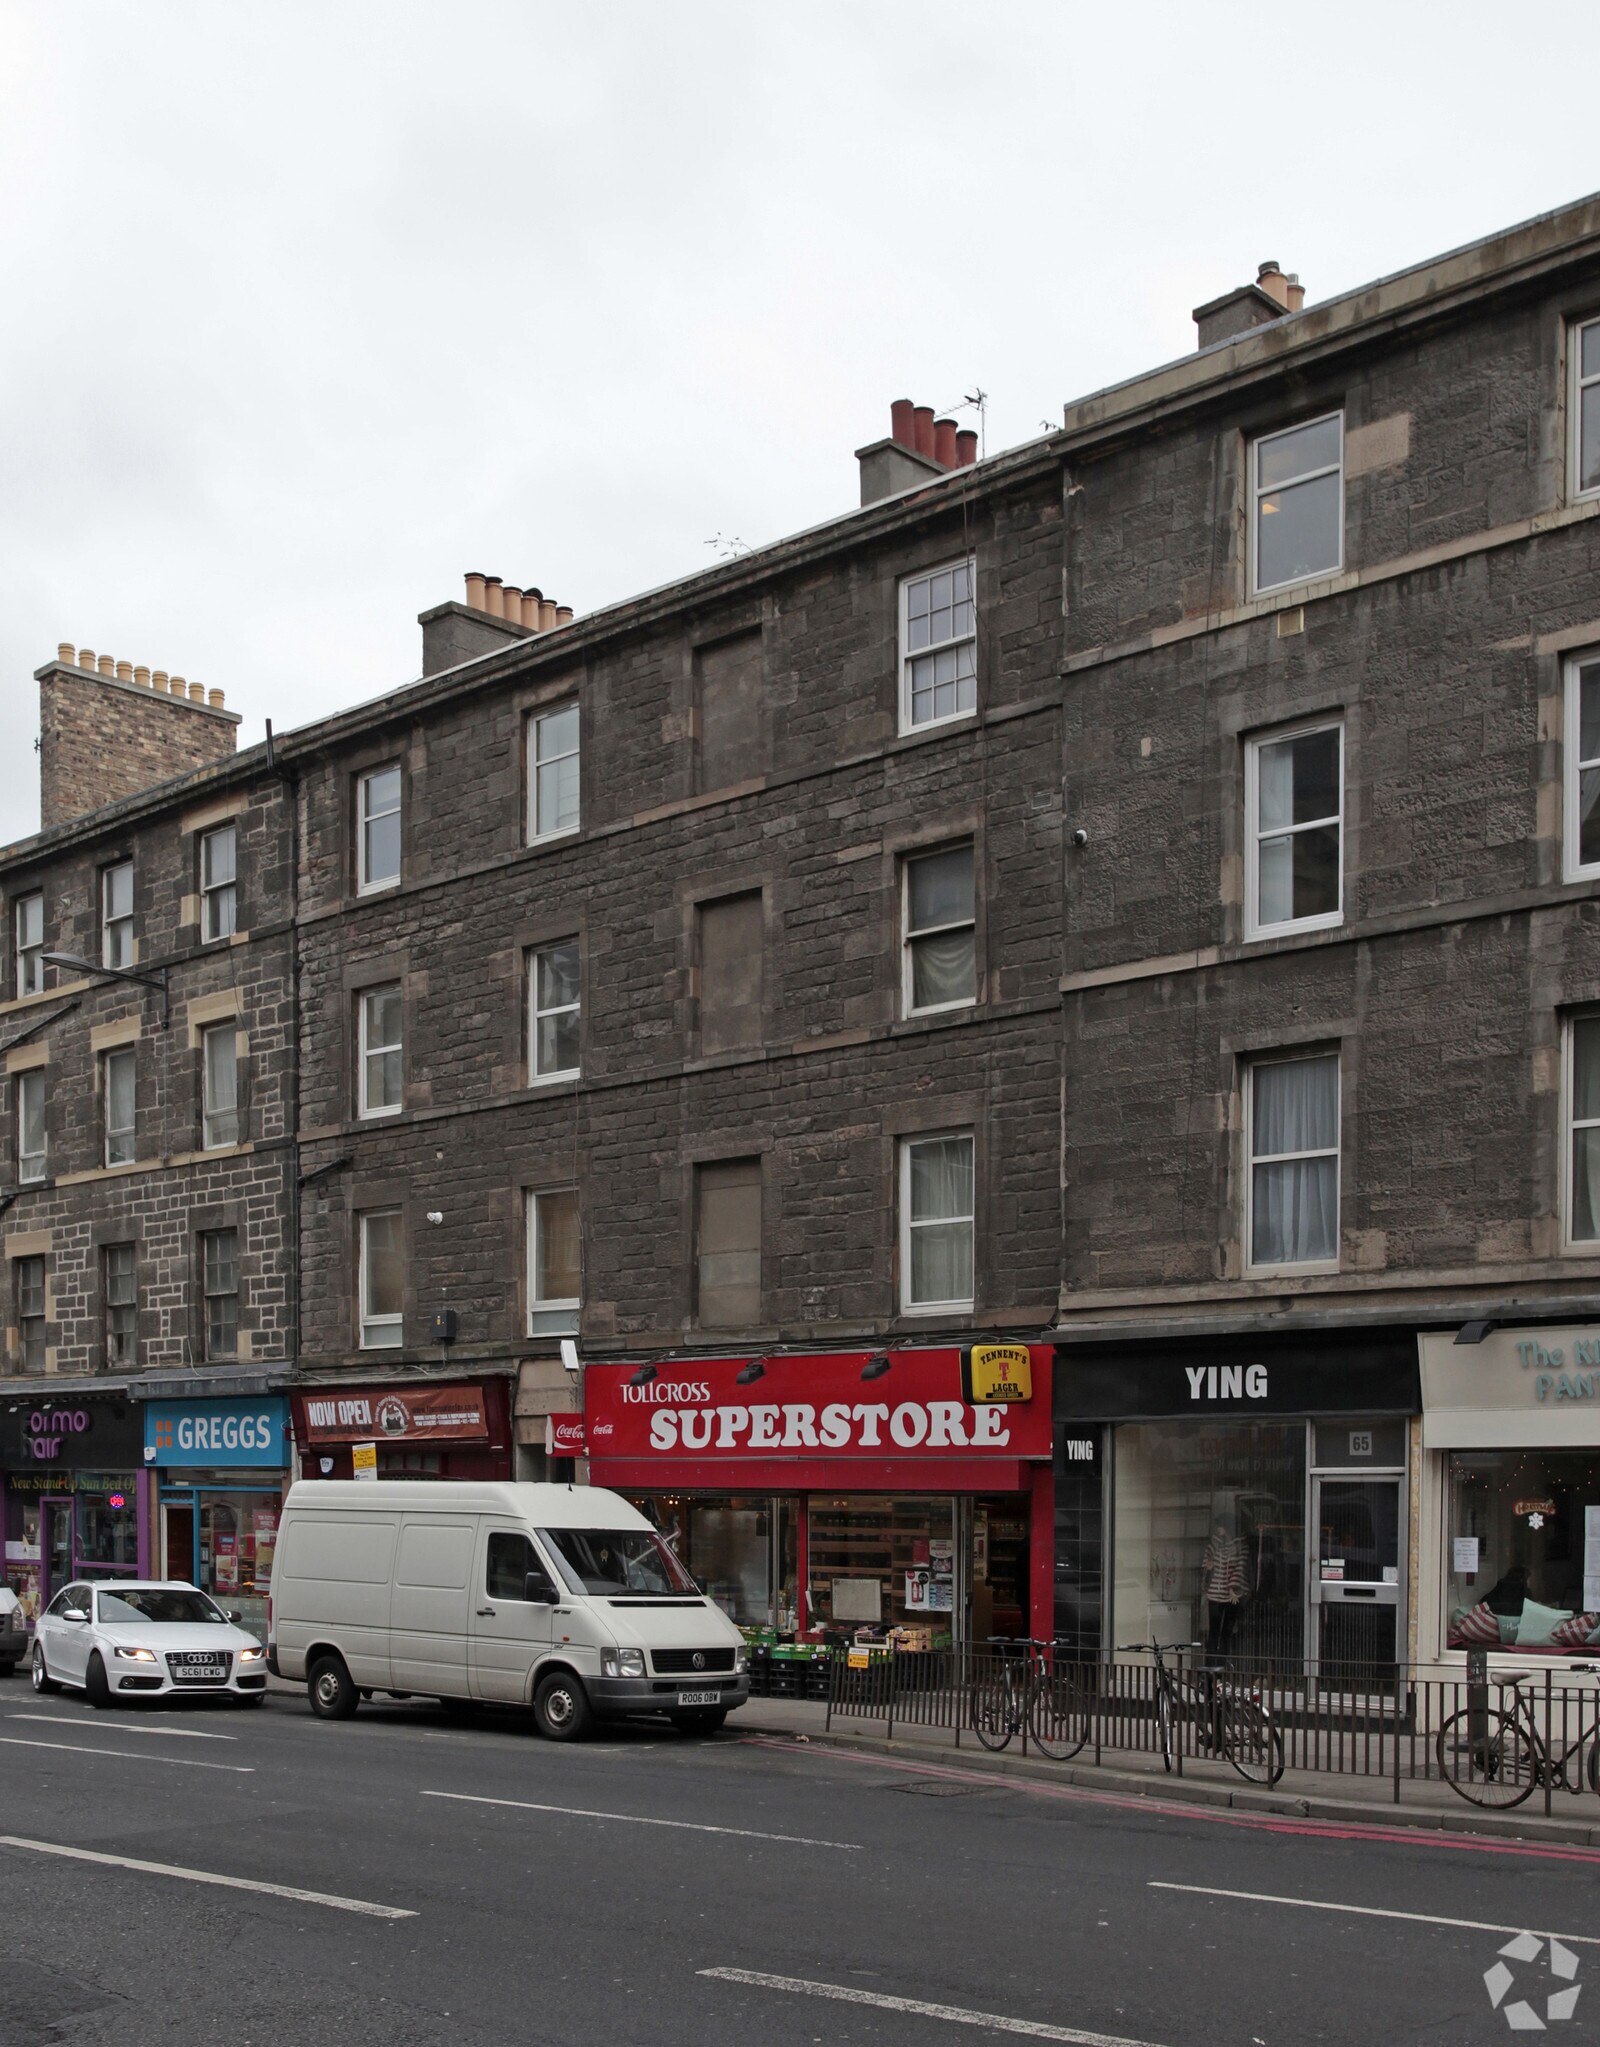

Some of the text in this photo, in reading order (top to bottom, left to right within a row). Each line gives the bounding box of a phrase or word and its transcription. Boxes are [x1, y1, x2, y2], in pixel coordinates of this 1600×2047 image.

[980, 1349, 1028, 1365] TENNENT'S
[1515, 1340, 1564, 1368] The
[992, 1383, 1019, 1392] LAGER
[1185, 1364, 1268, 1399] YING
[620, 1382, 710, 1404] TOLLCROSS
[308, 1402, 337, 1427] NOW
[337, 1399, 373, 1425] OPEN
[177, 1415, 272, 1449] GREGGS
[649, 1401, 1011, 1450] SUPERSTORE
[1067, 1440, 1094, 1461] YING
[1353, 1435, 1370, 1452] 65
[10, 1476, 31, 1489] New
[80, 1475, 100, 1490] Sun
[102, 1475, 122, 1490] Bed
[182, 1667, 221, 1677] SC61 CWG
